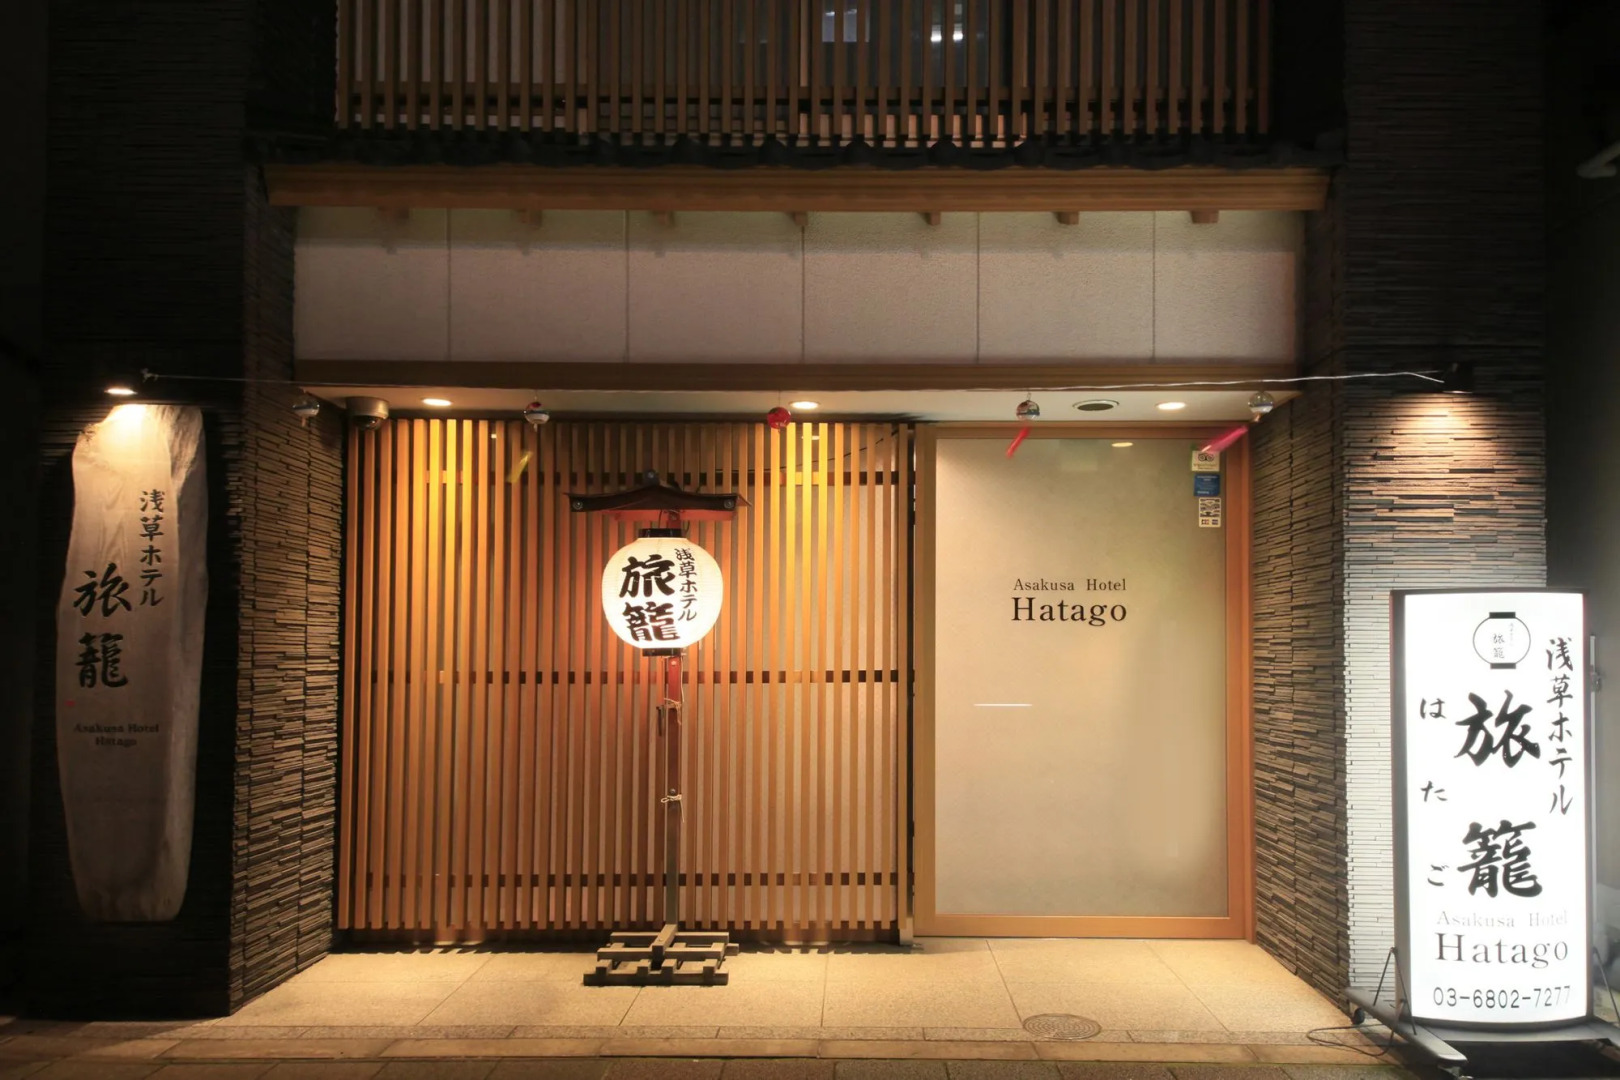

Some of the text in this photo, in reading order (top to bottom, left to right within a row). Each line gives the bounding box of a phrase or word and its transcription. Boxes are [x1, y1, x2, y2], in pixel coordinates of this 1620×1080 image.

[140, 488, 165, 607] 浅草ホテル
[619, 554, 681, 642] 旅籠
[673, 547, 698, 621] 浅草ホテル
[1011, 597, 1127, 626] Hatago
[1013, 578, 1127, 591] Asakusa Hotel
[73, 562, 132, 688] 旅籠
[73, 722, 160, 733] Asakusa Hotel
[1545, 637, 1574, 815] 浅草ホテル
[1454, 689, 1543, 898] 旅籠
[1436, 908, 1568, 928] Asakusa Hotel
[1434, 932, 1568, 969] Hatago
[1433, 985, 1572, 1009] 03-6802-7277
